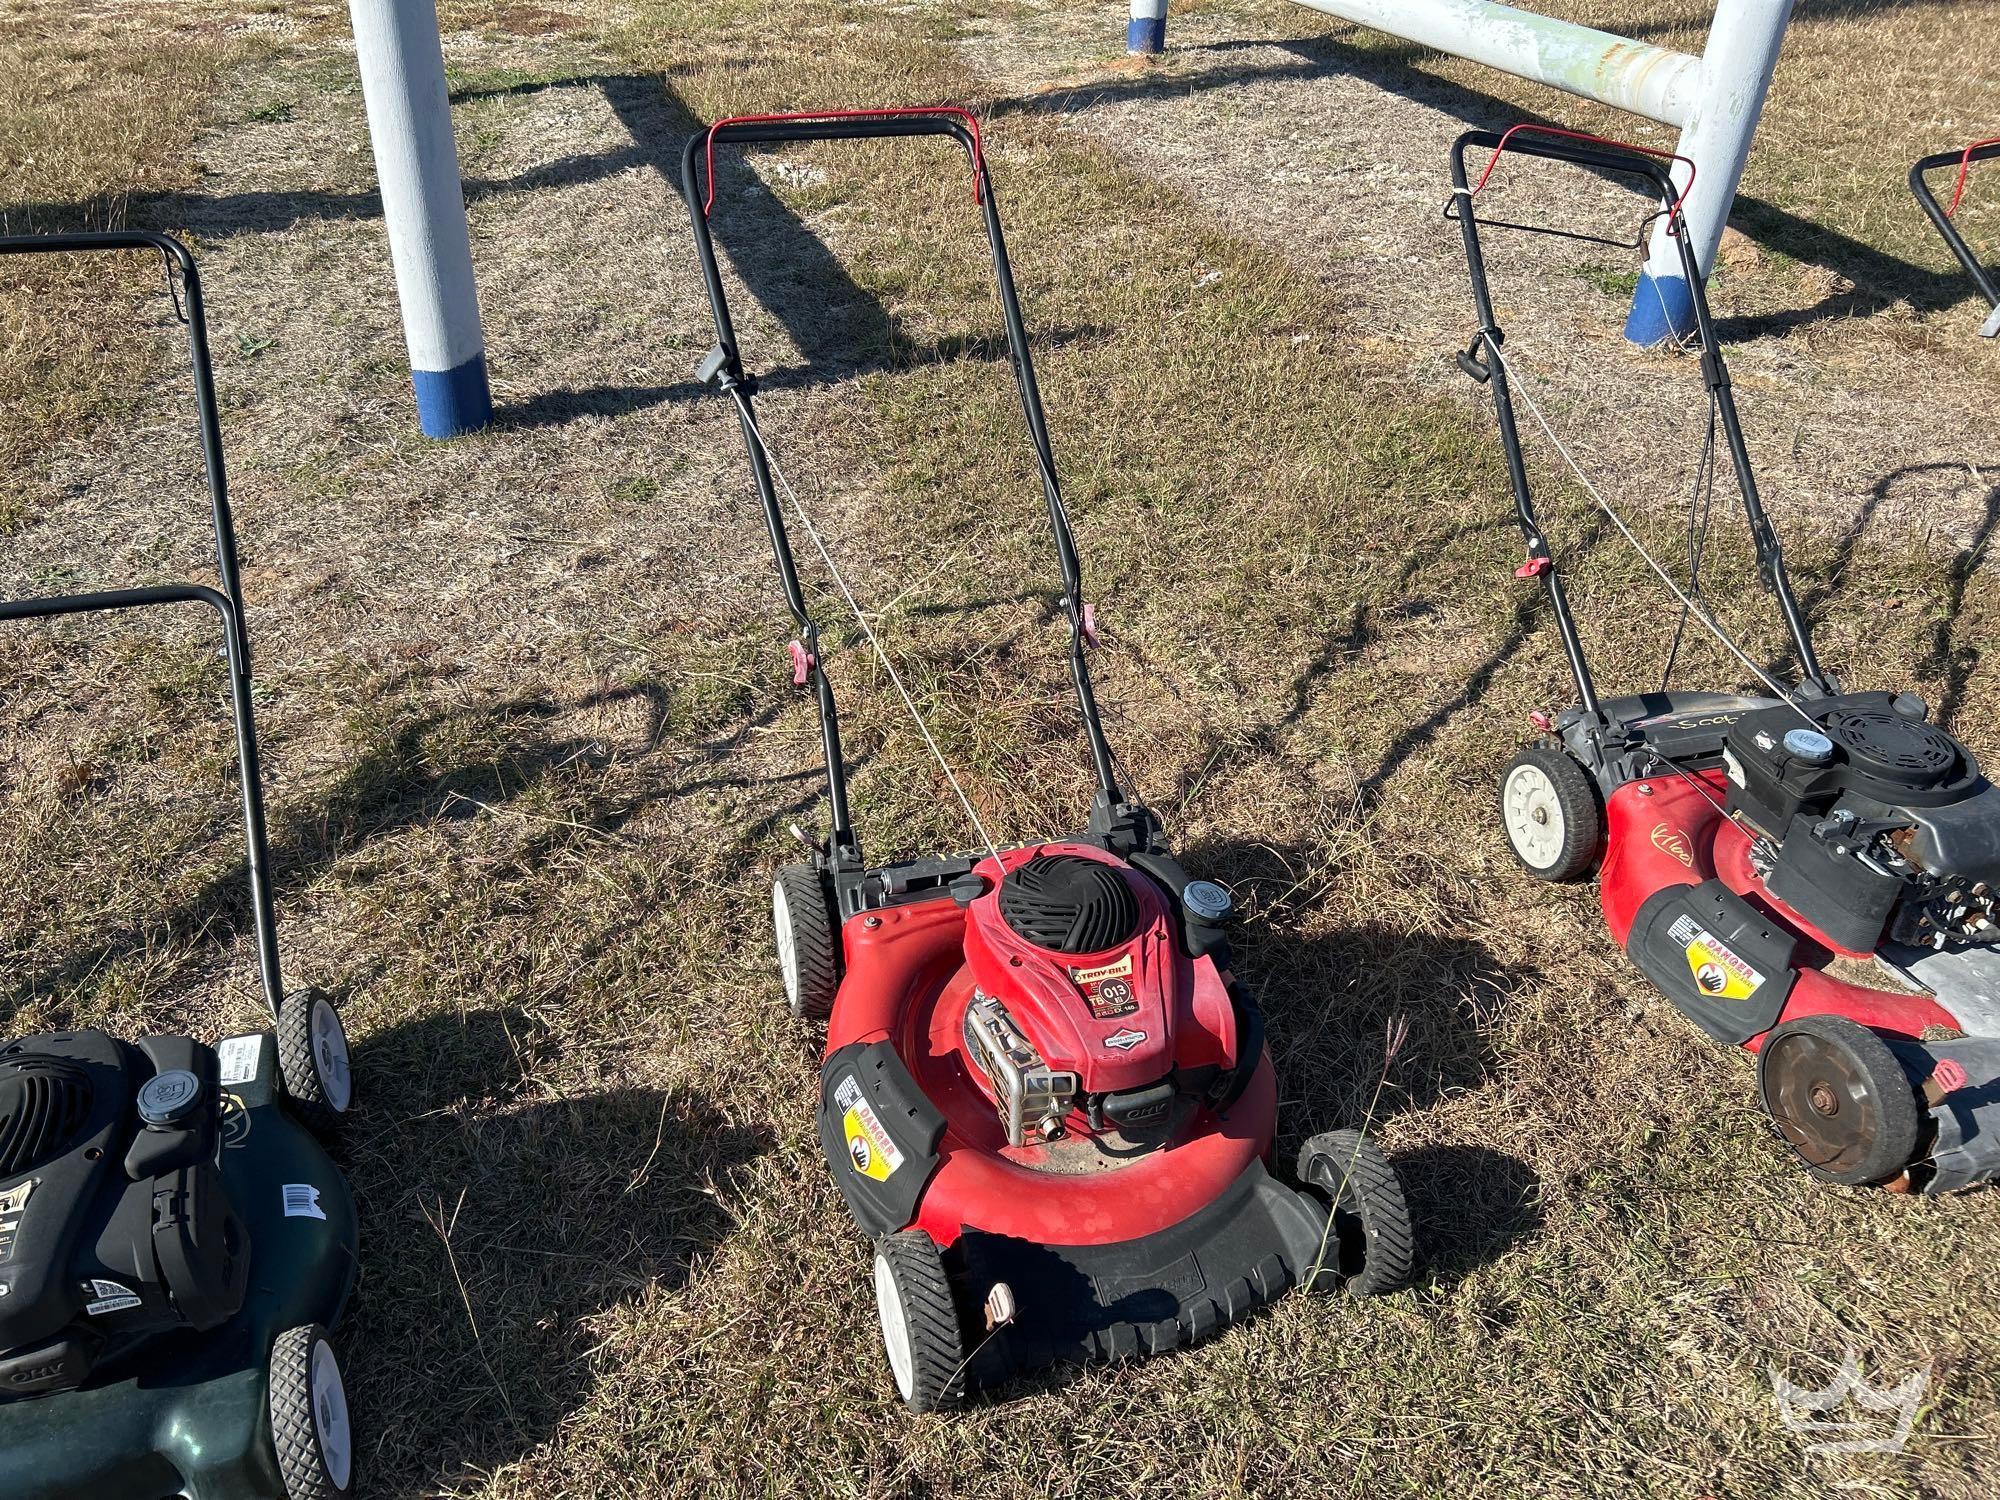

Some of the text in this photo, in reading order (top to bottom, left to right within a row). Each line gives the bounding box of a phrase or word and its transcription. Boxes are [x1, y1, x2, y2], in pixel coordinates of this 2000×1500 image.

[1695, 940, 1709, 953] KEEP
[1738, 976, 1754, 990] AWAY
[1706, 938, 1754, 979] DANGER
[1103, 984, 1127, 998] 013
[1126, 1102, 1166, 1119] OHV
[858, 1107, 896, 1157] DANGER
[10, 1360, 65, 1383] OHV
